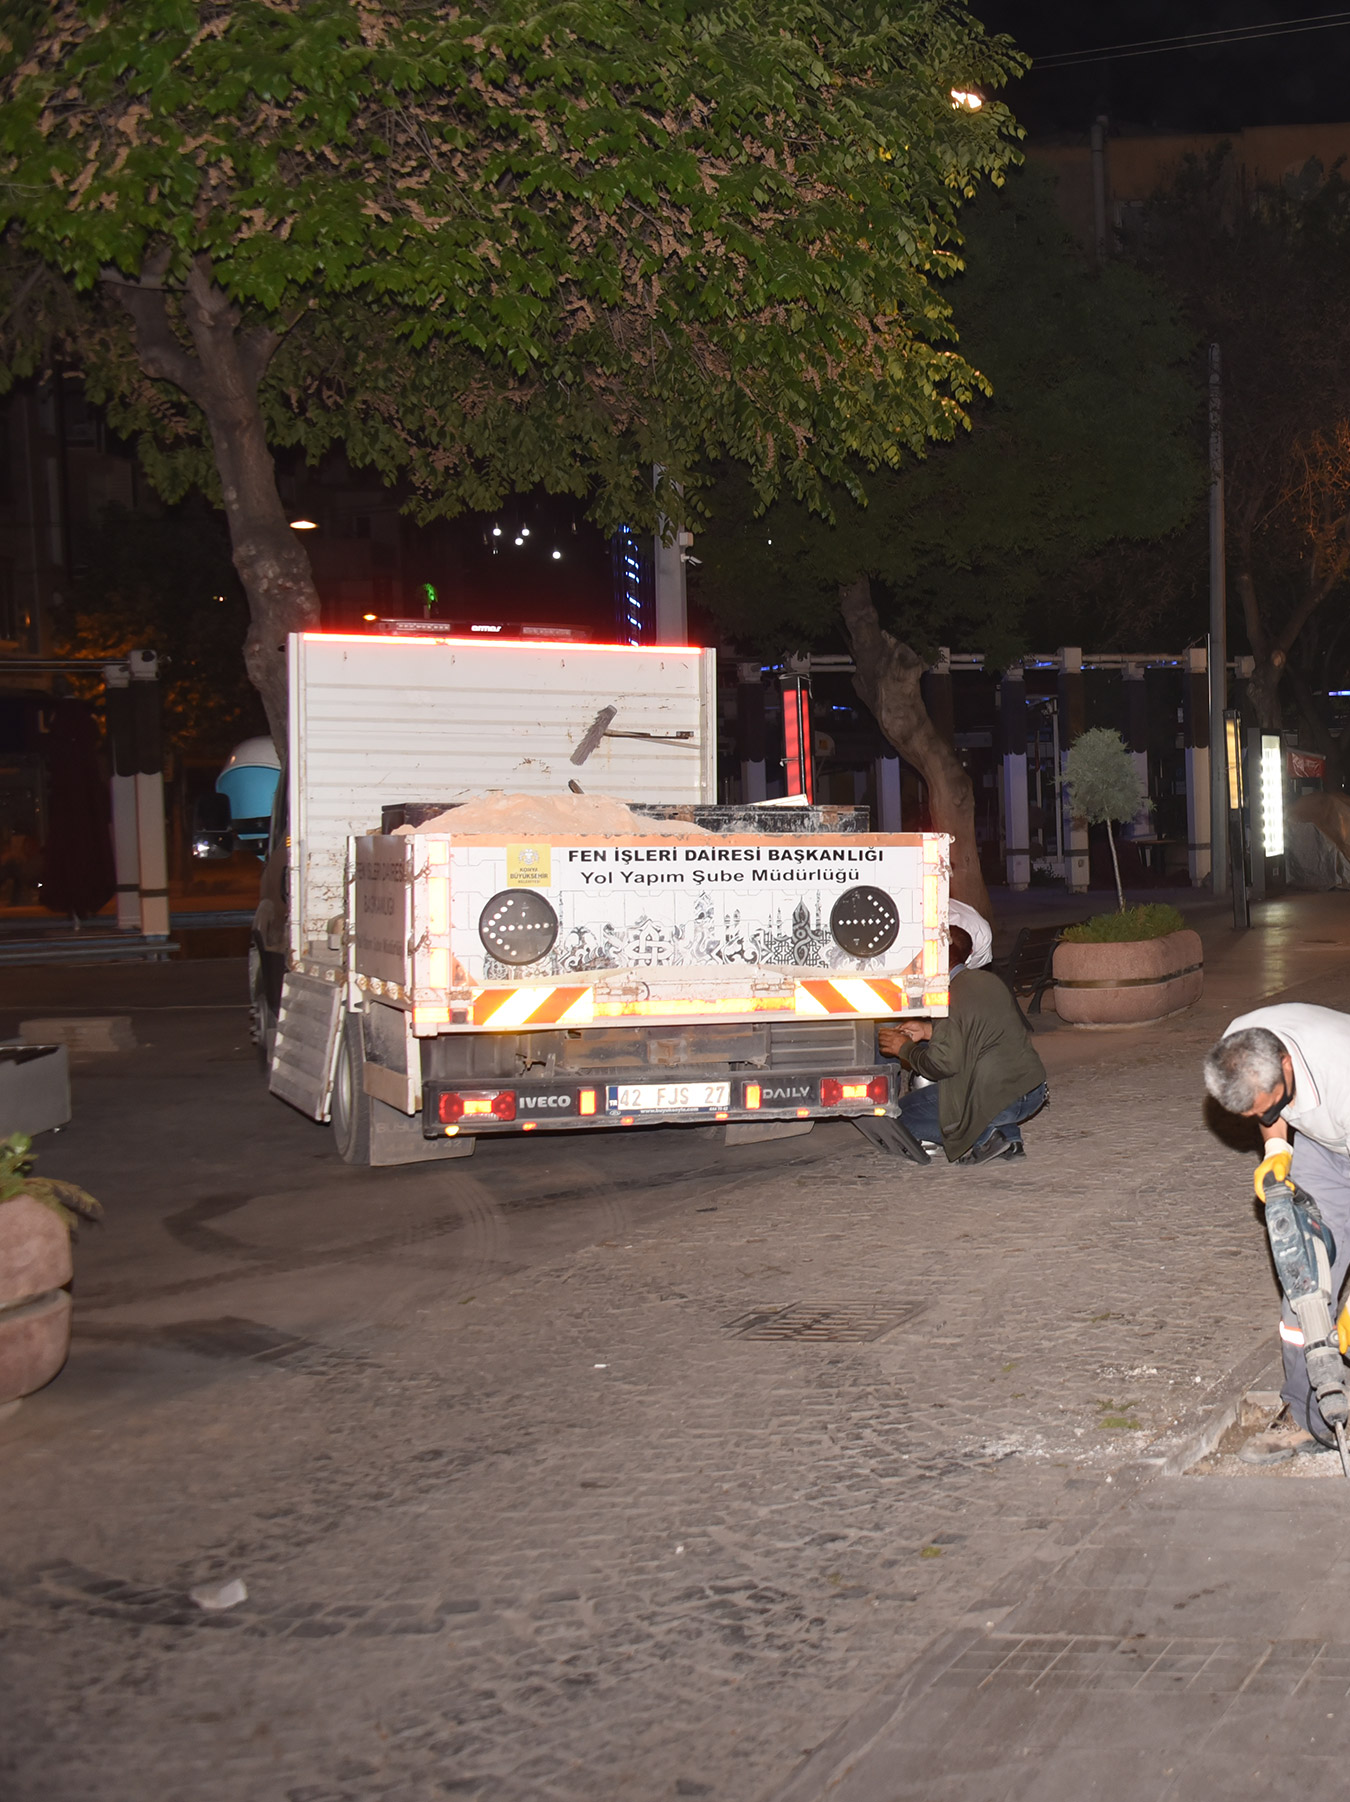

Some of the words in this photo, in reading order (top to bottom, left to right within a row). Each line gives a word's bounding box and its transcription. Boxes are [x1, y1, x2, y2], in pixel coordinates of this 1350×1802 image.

[568, 850, 607, 862] FEN
[614, 847, 678, 865] İŞLERİ
[685, 846, 761, 862] DAİRESİ
[768, 845, 884, 864] BAŞKANLIĞI
[581, 871, 613, 885] Yol
[620, 870, 684, 886] Yapım
[692, 869, 744, 886] Şube
[752, 868, 860, 884] Müdürlüğü
[620, 1089, 641, 1107] 42
[656, 1087, 689, 1106] FJS
[704, 1085, 726, 1104] 27
[763, 1086, 810, 1100] DAILY
[519, 1095, 572, 1108] IVECO
[443, 1140, 463, 1148] 42
